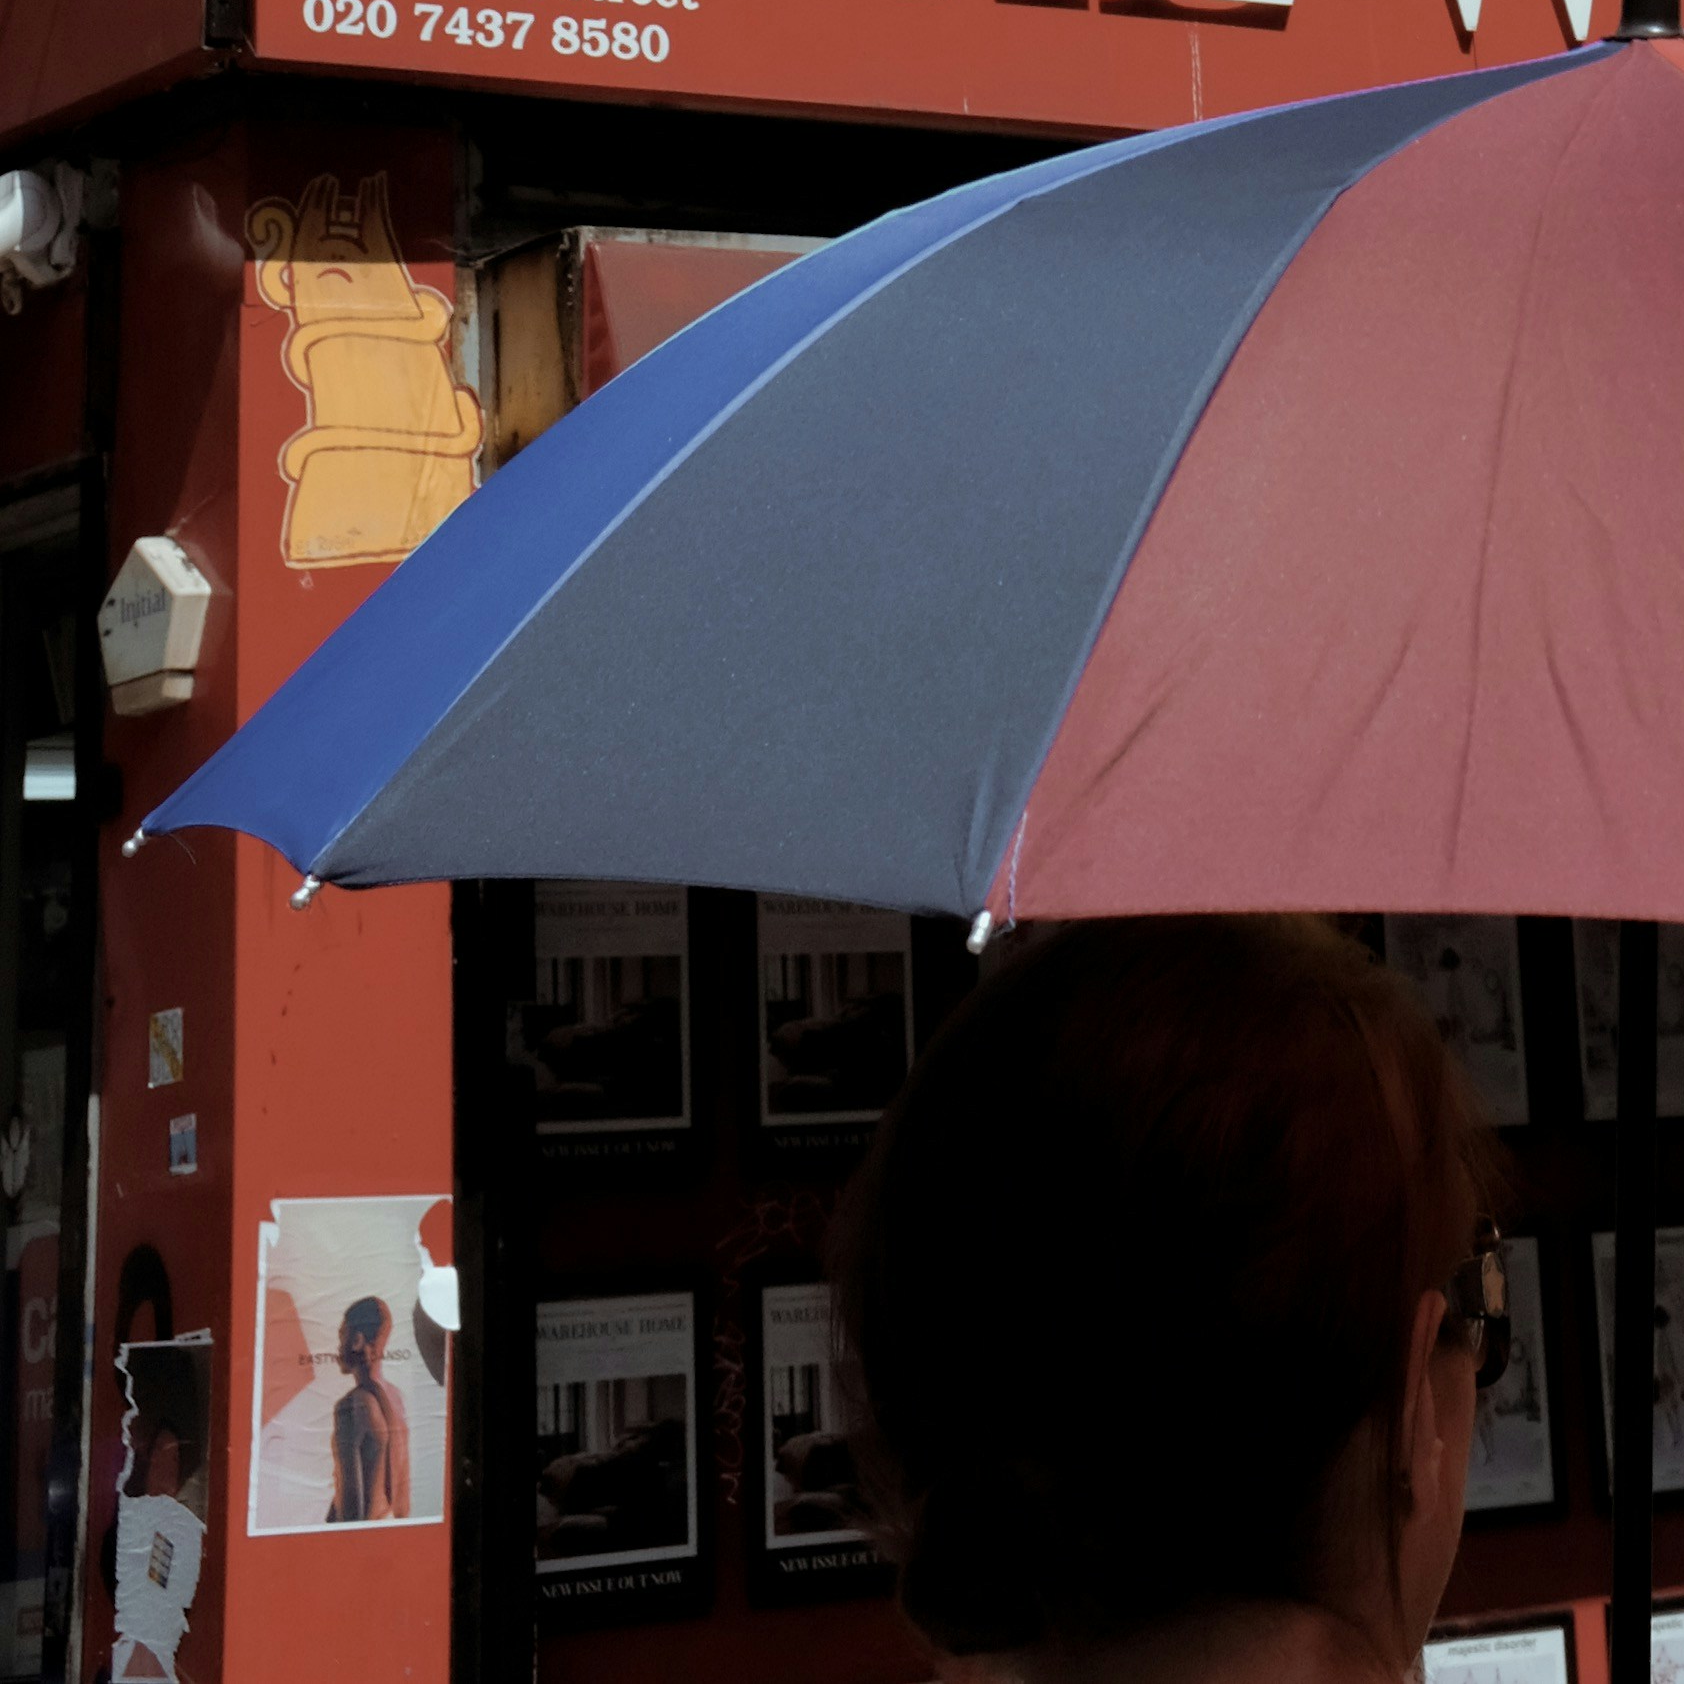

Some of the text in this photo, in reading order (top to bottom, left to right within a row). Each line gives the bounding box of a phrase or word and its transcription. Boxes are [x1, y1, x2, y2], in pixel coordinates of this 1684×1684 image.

[413, 2, 535, 50] 7437
[551, 15, 671, 64] 8580
[120, 587, 167, 623] Initial
[639, 1316, 687, 1334] HOME
[779, 1559, 810, 1574] NEW
[812, 1555, 852, 1571] ISSUE
[541, 1570, 683, 1599] NEW ISSUE OUT NOW
